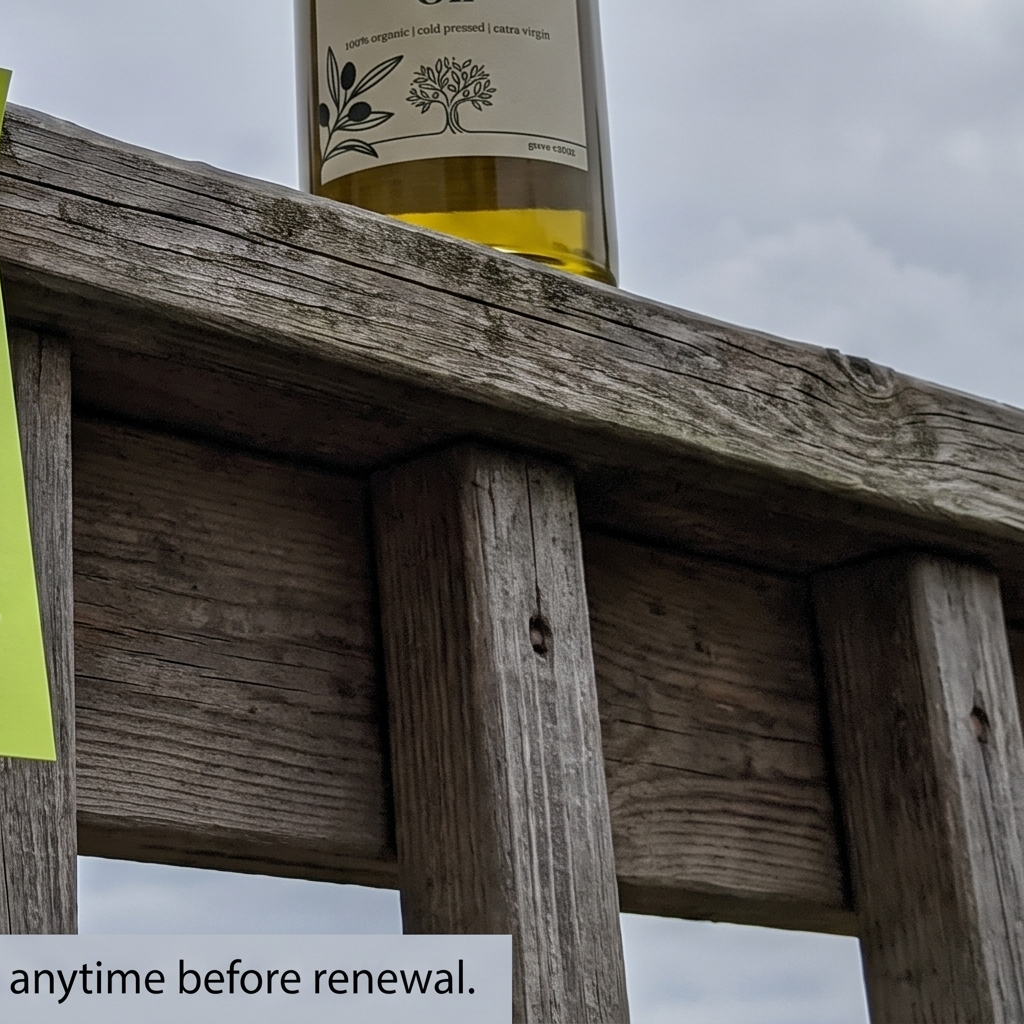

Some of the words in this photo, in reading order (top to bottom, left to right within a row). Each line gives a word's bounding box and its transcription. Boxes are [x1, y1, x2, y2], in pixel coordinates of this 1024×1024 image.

[371, 27, 410, 44] organic
[417, 23, 441, 36] cold
[443, 22, 485, 36] pressed
[521, 26, 551, 41] virgin
